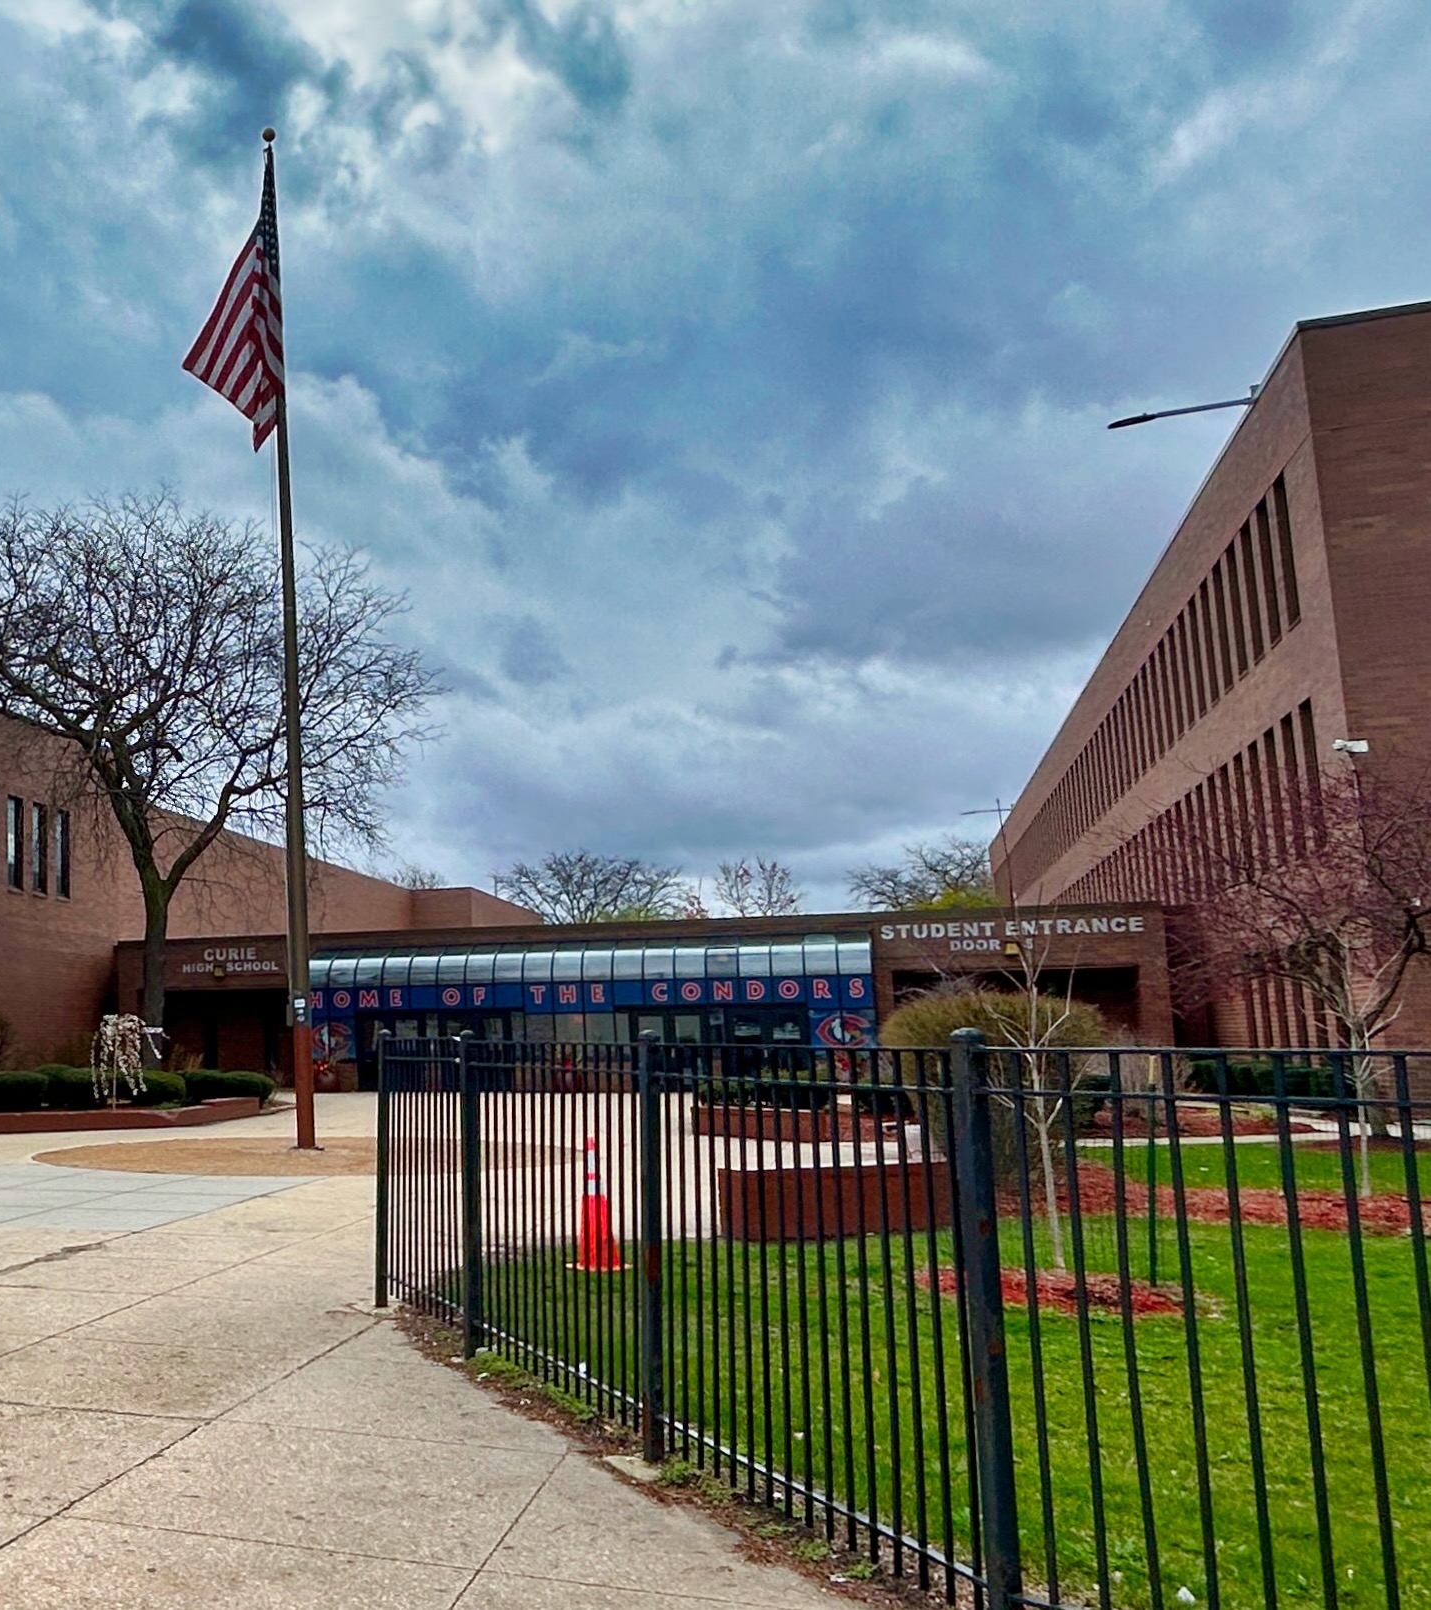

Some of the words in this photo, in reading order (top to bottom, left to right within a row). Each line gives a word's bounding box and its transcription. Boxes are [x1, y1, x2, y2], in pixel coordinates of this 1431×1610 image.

[880, 921, 996, 940] STUDENT
[1005, 916, 1145, 936] ENTRANCE
[950, 939, 1001, 951] DOOR
[203, 947, 257, 961] CURIE
[182, 963, 214, 974] HIGH
[226, 961, 279, 972] SCHOOL
[310, 988, 403, 1009] HOME
[442, 987, 486, 1006] OF
[529, 984, 605, 1004] THE
[651, 978, 865, 1002] CONDORS
